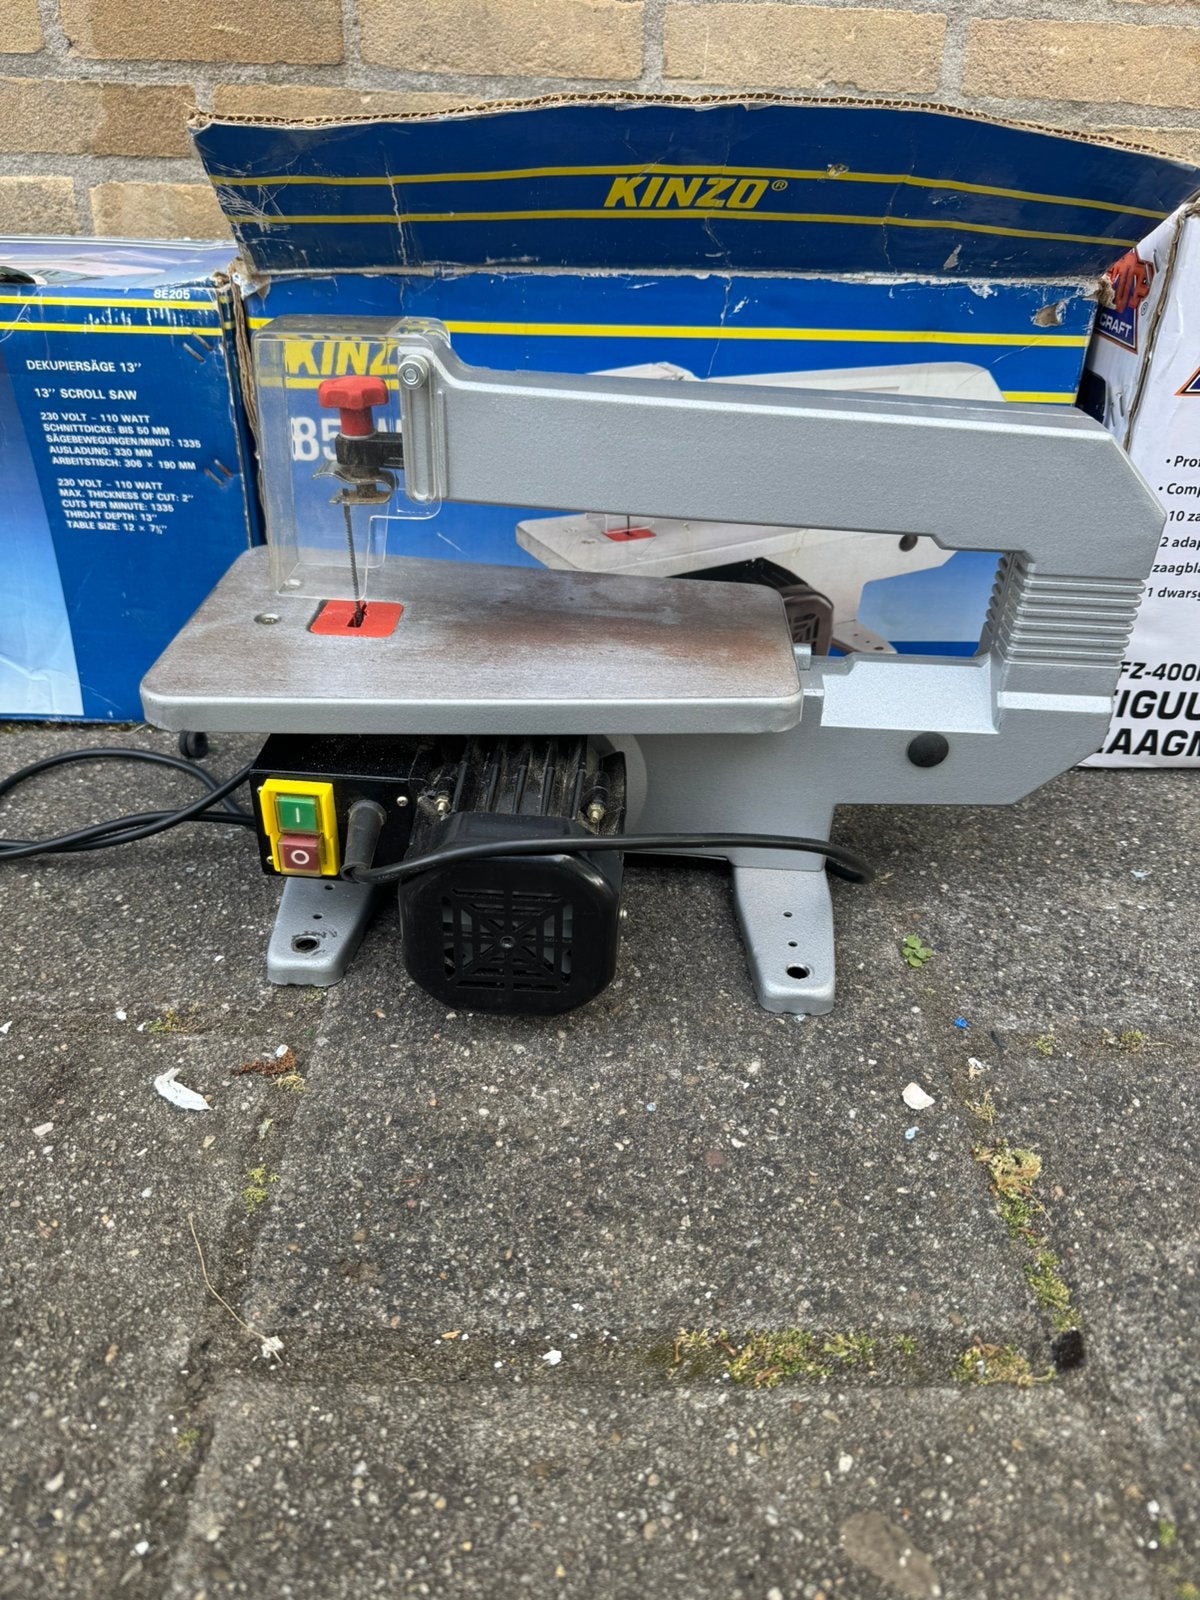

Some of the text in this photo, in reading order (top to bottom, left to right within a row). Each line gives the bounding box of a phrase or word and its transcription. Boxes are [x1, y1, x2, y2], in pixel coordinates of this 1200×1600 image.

[1100, 313, 1132, 338] CRAFT
[284, 335, 400, 376] KINZ
[26, 359, 116, 373] DEKUPIERSÄGE
[60, 389, 105, 400] SCROLL
[109, 390, 137, 400] SAW
[40, 412, 58, 421] 230
[62, 413, 87, 422] VOLT
[100, 414, 118, 423] 110
[121, 415, 150, 424] WATT
[43, 423, 170, 436] SCHNITTDICKE: BIS 50 MM
[178, 438, 201, 448] 1335
[50, 446, 153, 457] AUSLADUNG: 330 MM
[52, 457, 122, 468] ARBEITSTISCH:
[124, 459, 142, 468] 306
[159, 461, 176, 469] 190
[178, 461, 196, 470] MM
[57, 478, 75, 487] 230
[77, 479, 102, 488] VOLT
[115, 480, 132, 489] 110
[134, 481, 163, 490] WATT
[59, 489, 85, 498] MAX.
[88, 490, 139, 500] THICKNESS
[142, 492, 154, 500] OF
[156, 493, 179, 502] CUT:
[62, 499, 174, 512] CUTS PER MINUTE: 1335
[64, 510, 101, 519] THROAT
[104, 511, 137, 521] DEPTH:
[1169, 511, 1185, 521] 10
[66, 520, 95, 529] TABLE
[98, 521, 120, 531] SIZE:
[123, 522, 135, 531] 12
[1160, 537, 1169, 547] 2
[1147, 587, 1153, 597] 1
[1113, 689, 1200, 720] IGUU
[1096, 728, 1200, 756] AAG
